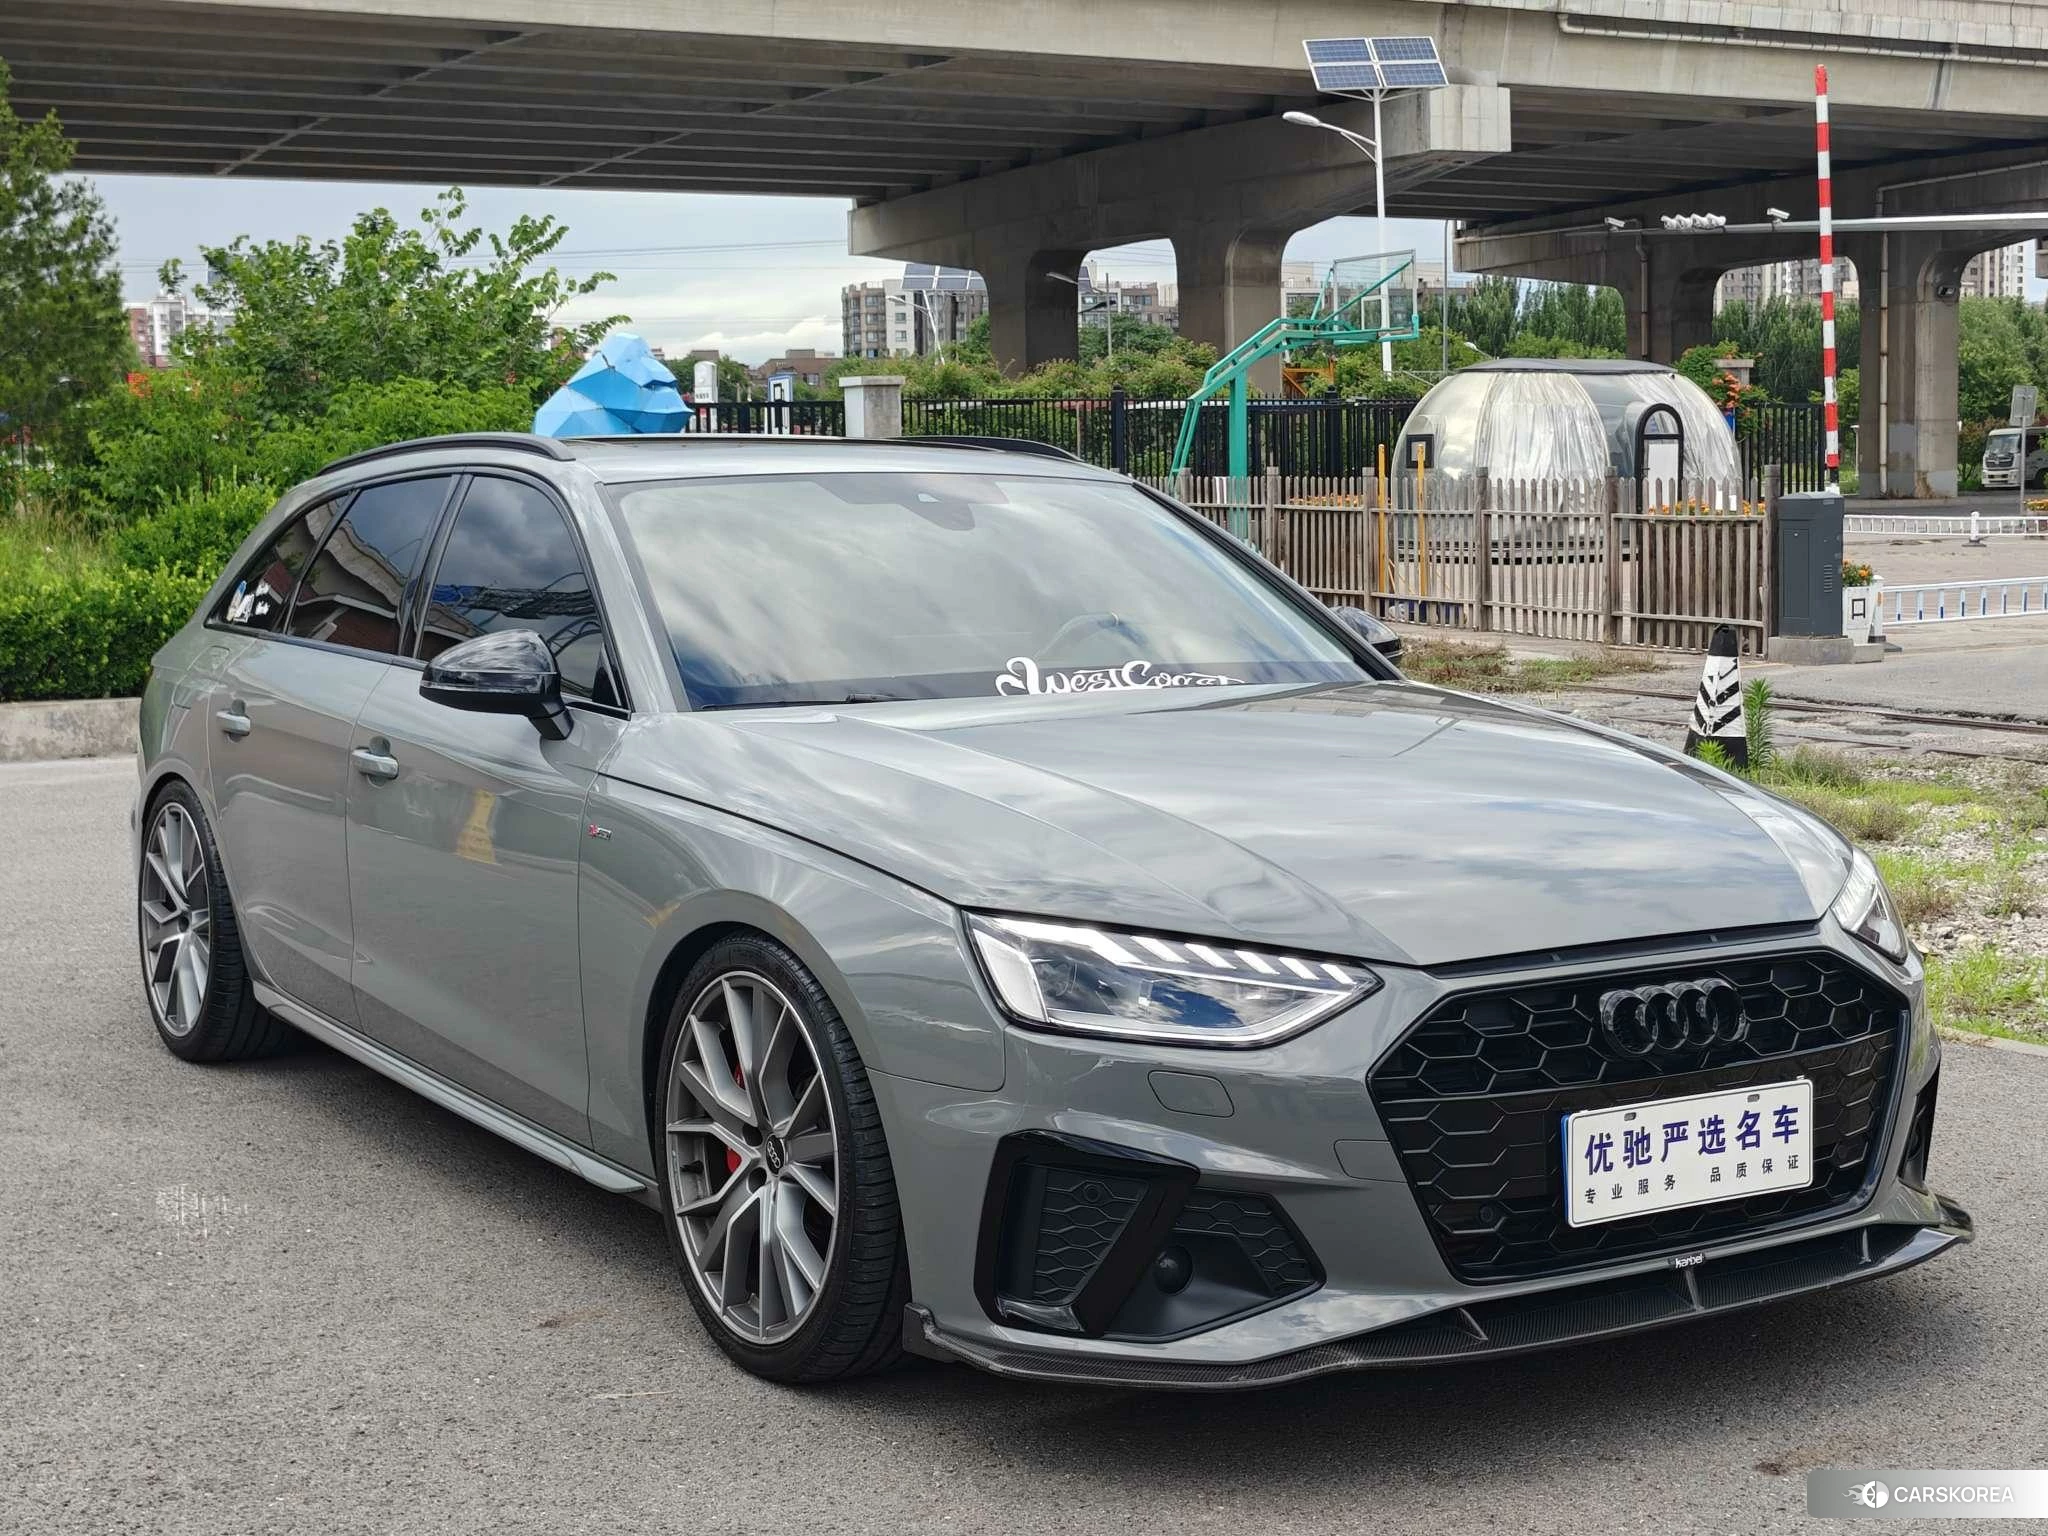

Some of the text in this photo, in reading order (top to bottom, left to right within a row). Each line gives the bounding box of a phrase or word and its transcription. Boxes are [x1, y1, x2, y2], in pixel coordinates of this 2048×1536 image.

[1584, 1104, 1799, 1176] 优驰严选名车
[1585, 1154, 1799, 1204] 专业服务 品质保证
